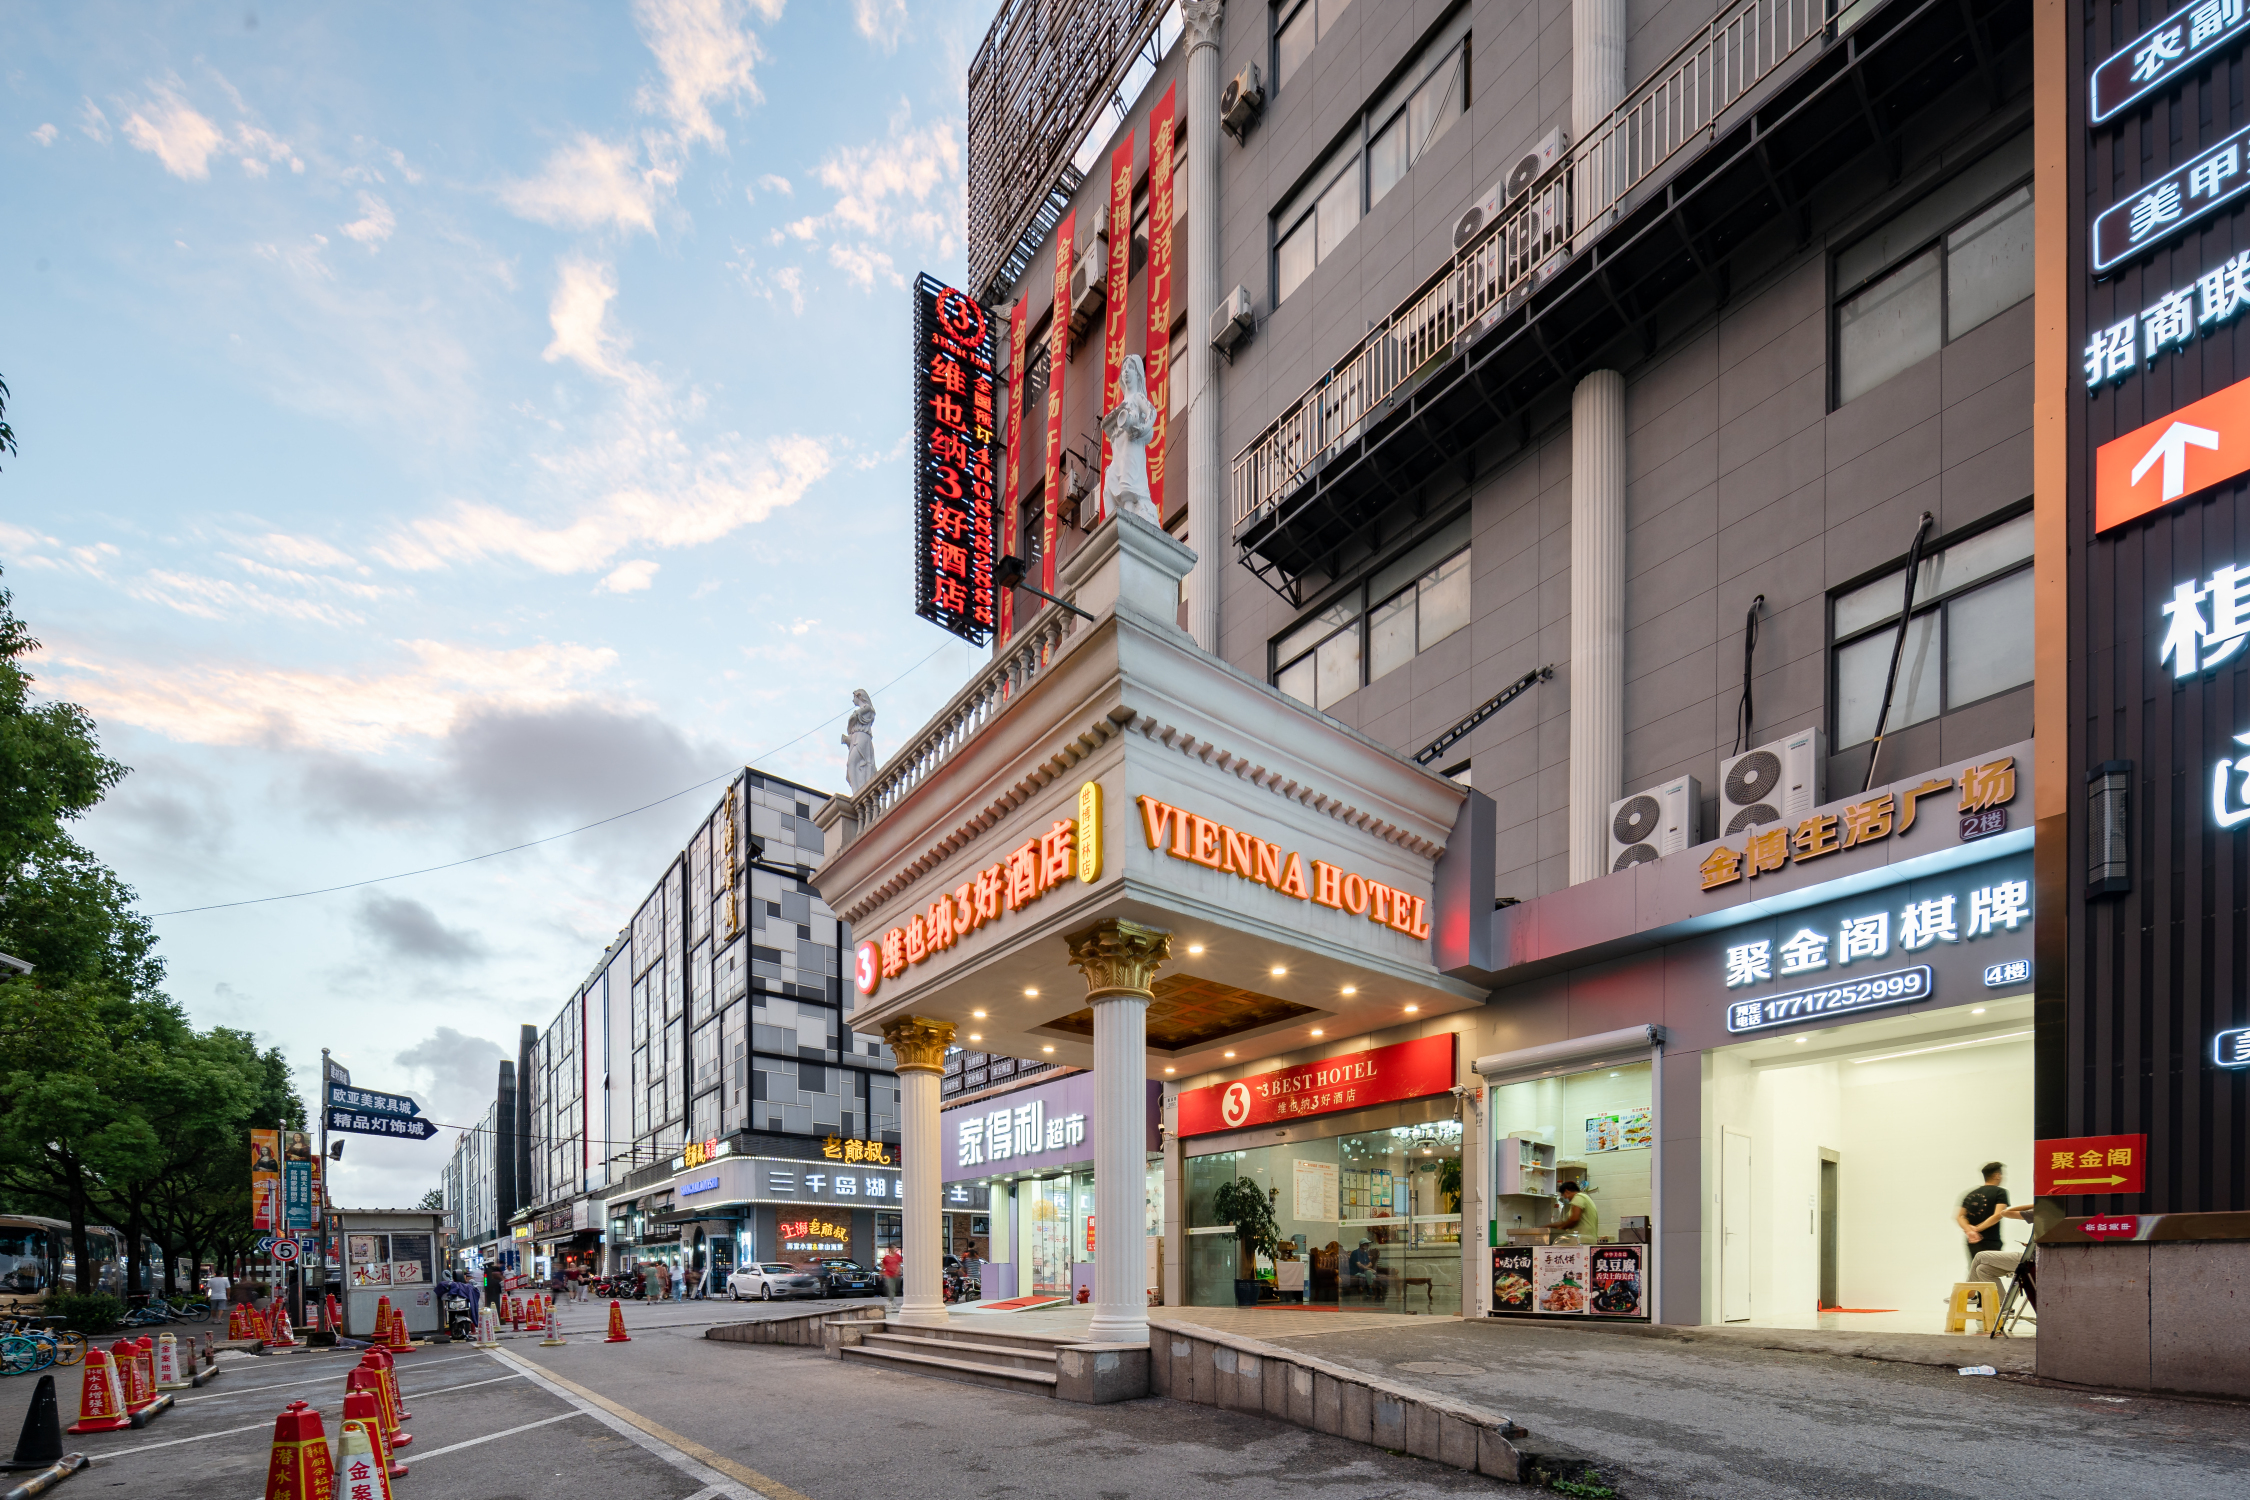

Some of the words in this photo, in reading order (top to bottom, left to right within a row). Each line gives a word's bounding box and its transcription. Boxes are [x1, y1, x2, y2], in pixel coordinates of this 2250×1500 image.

[2130, 0, 2250, 83] 农副
[2129, 140, 2250, 243] 美甲
[930, 353, 969, 615] 维也纳3好酒店
[972, 448, 993, 624] 4008882888
[1082, 788, 1091, 877] 世博三林店
[1700, 756, 2017, 891] 金博生活广场
[1964, 813, 2003, 837] 2楼
[1136, 794, 1309, 901] VIENNA
[1311, 859, 1430, 941] HOTEL
[882, 818, 1079, 979] 维也纳3好酒店
[1727, 880, 2031, 988] 聚金阁棋牌
[857, 947, 872, 989] 3
[1987, 962, 2027, 984] 4楼
[1764, 973, 1921, 1019] 17717252999
[1317, 1060, 1378, 1087] HOTEL
[333, 1088, 412, 1115] 欧亚美家具城
[1277, 1089, 1357, 1115] 维也纳3好酒店
[333, 1113, 425, 1136] 精品灯饰城
[2051, 1147, 2132, 1170] 聚金阁
[280, 1243, 293, 1258] 5
[1595, 1258, 1637, 1273] 臭豆腐
[1596, 1272, 1636, 1281] 舌尖上的美食
[161, 1345, 172, 1382] 金案地漏
